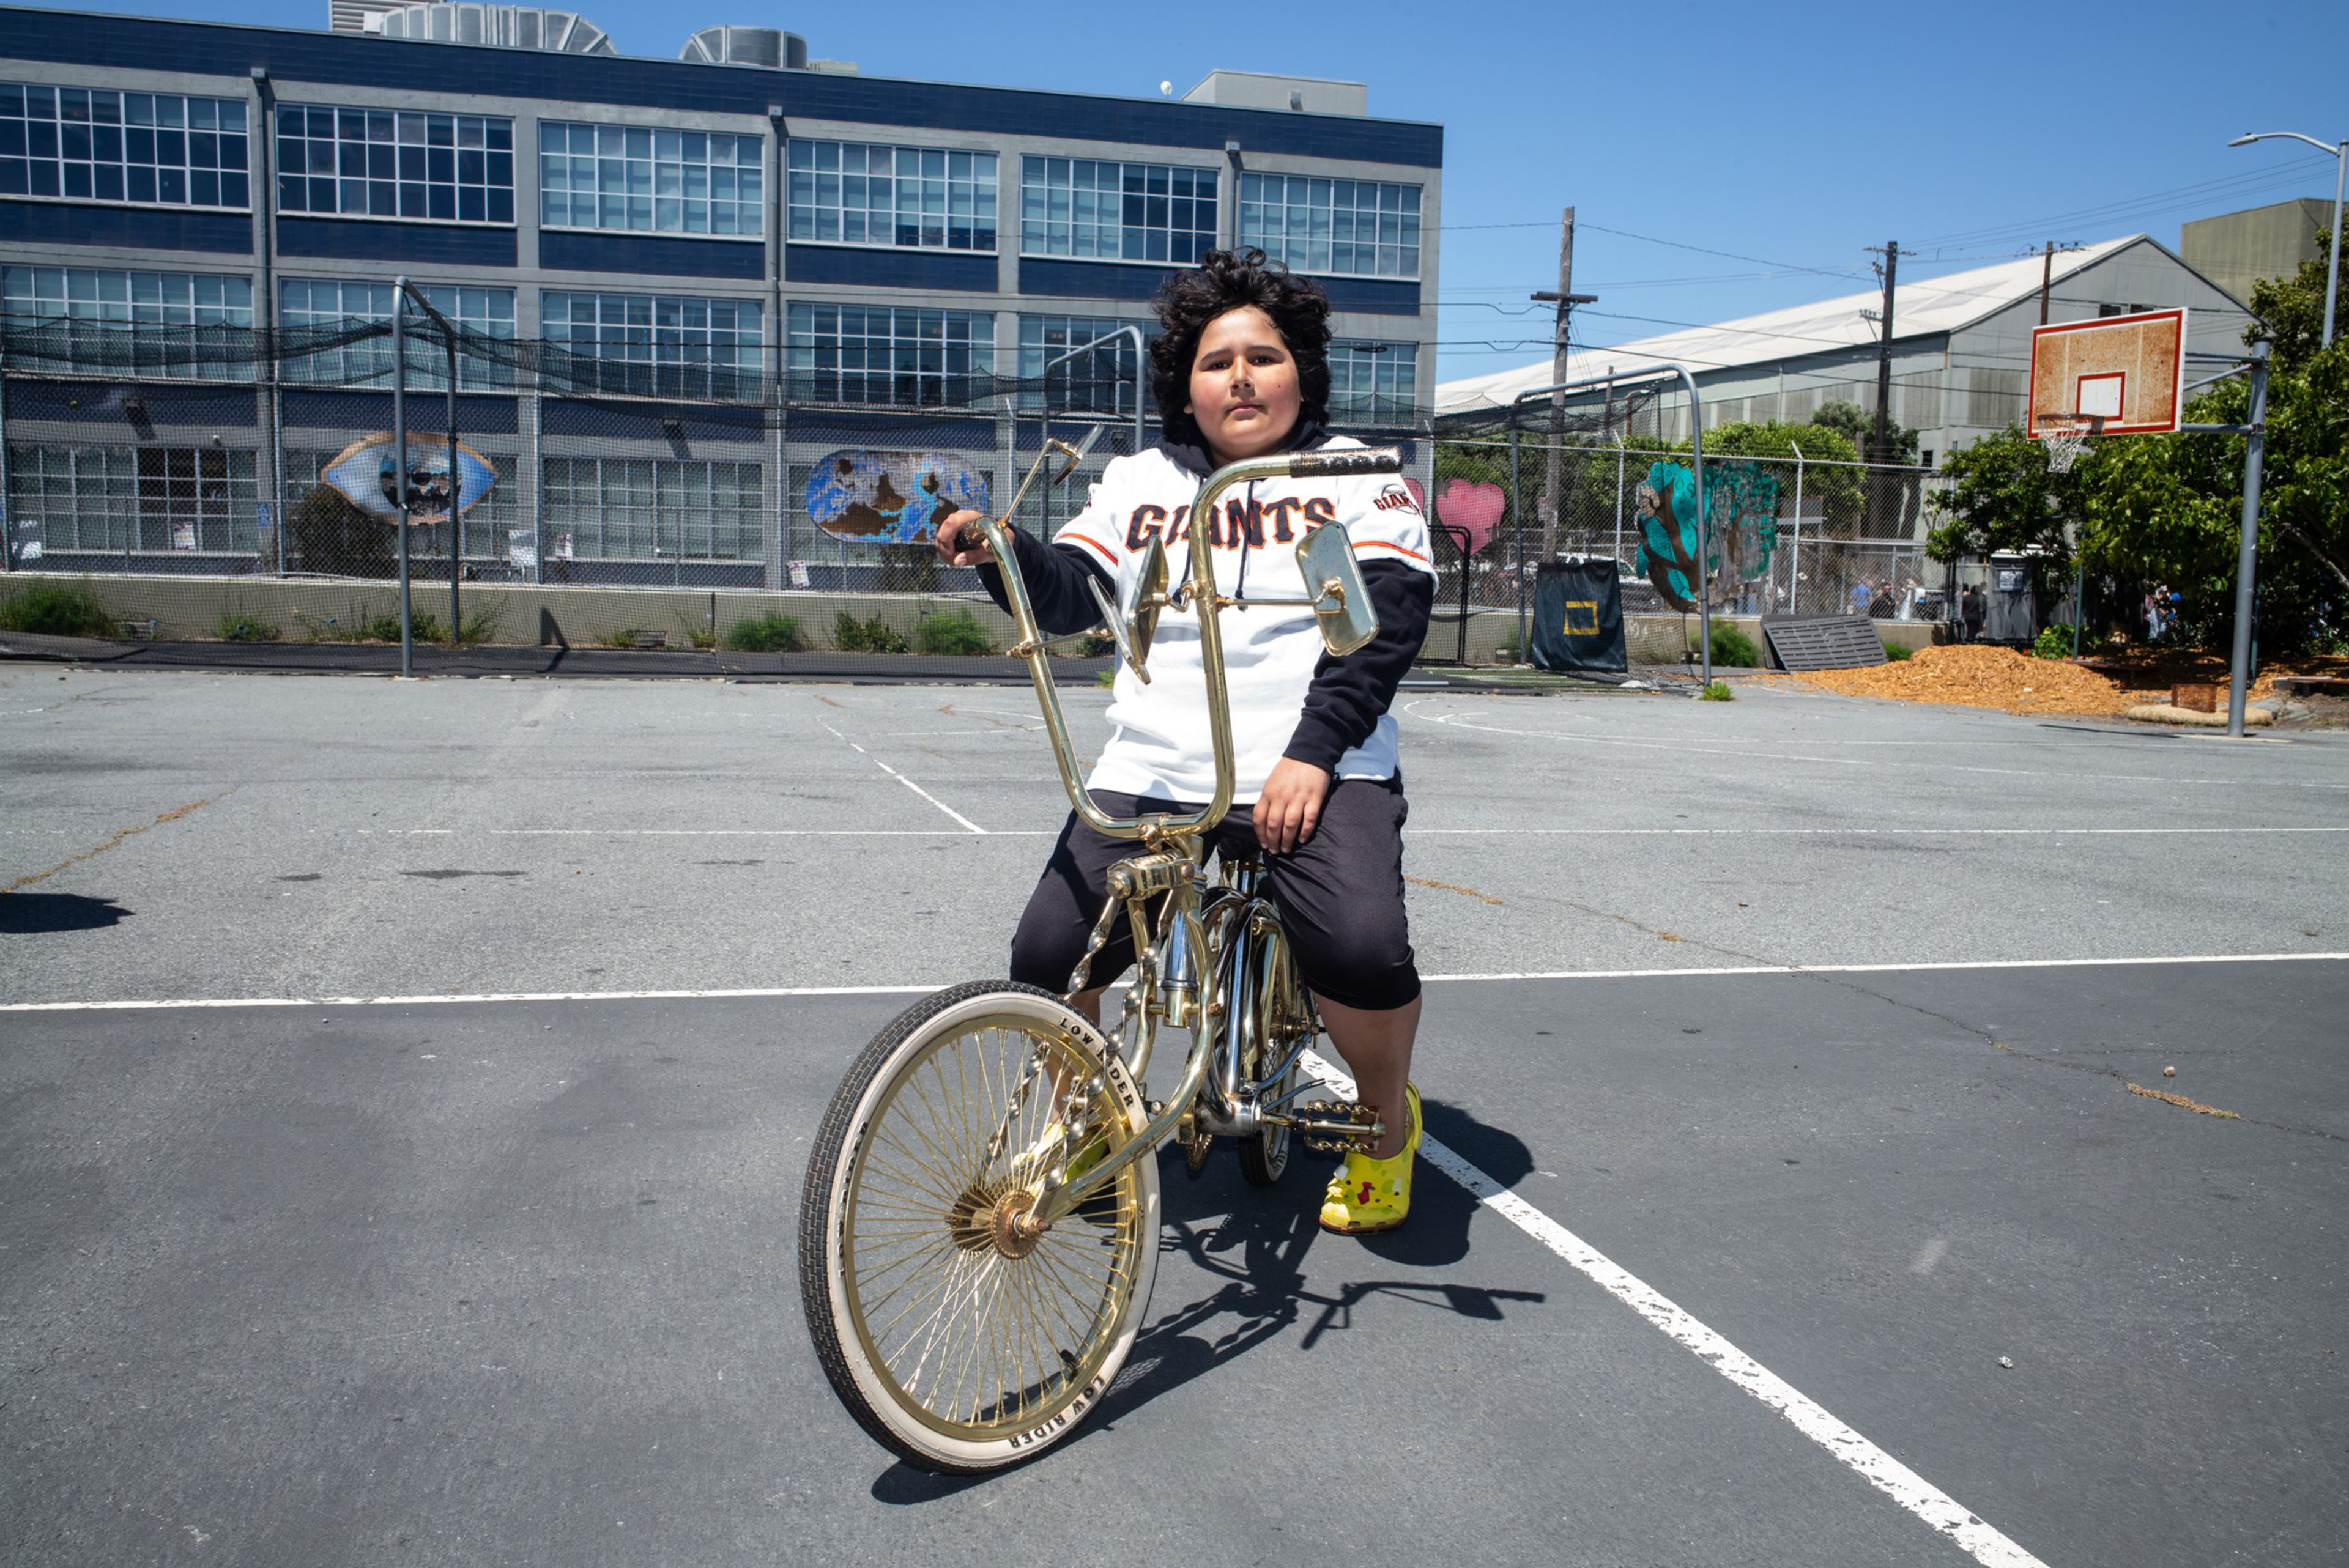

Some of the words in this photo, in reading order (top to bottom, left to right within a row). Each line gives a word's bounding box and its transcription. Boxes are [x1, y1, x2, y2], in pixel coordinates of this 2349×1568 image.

[1125, 497, 1335, 553] GIANTS
[1060, 1018, 1094, 1045] LOW
[1072, 1374, 1105, 1415] LOW
[1008, 1413, 1067, 1449] RIDER
